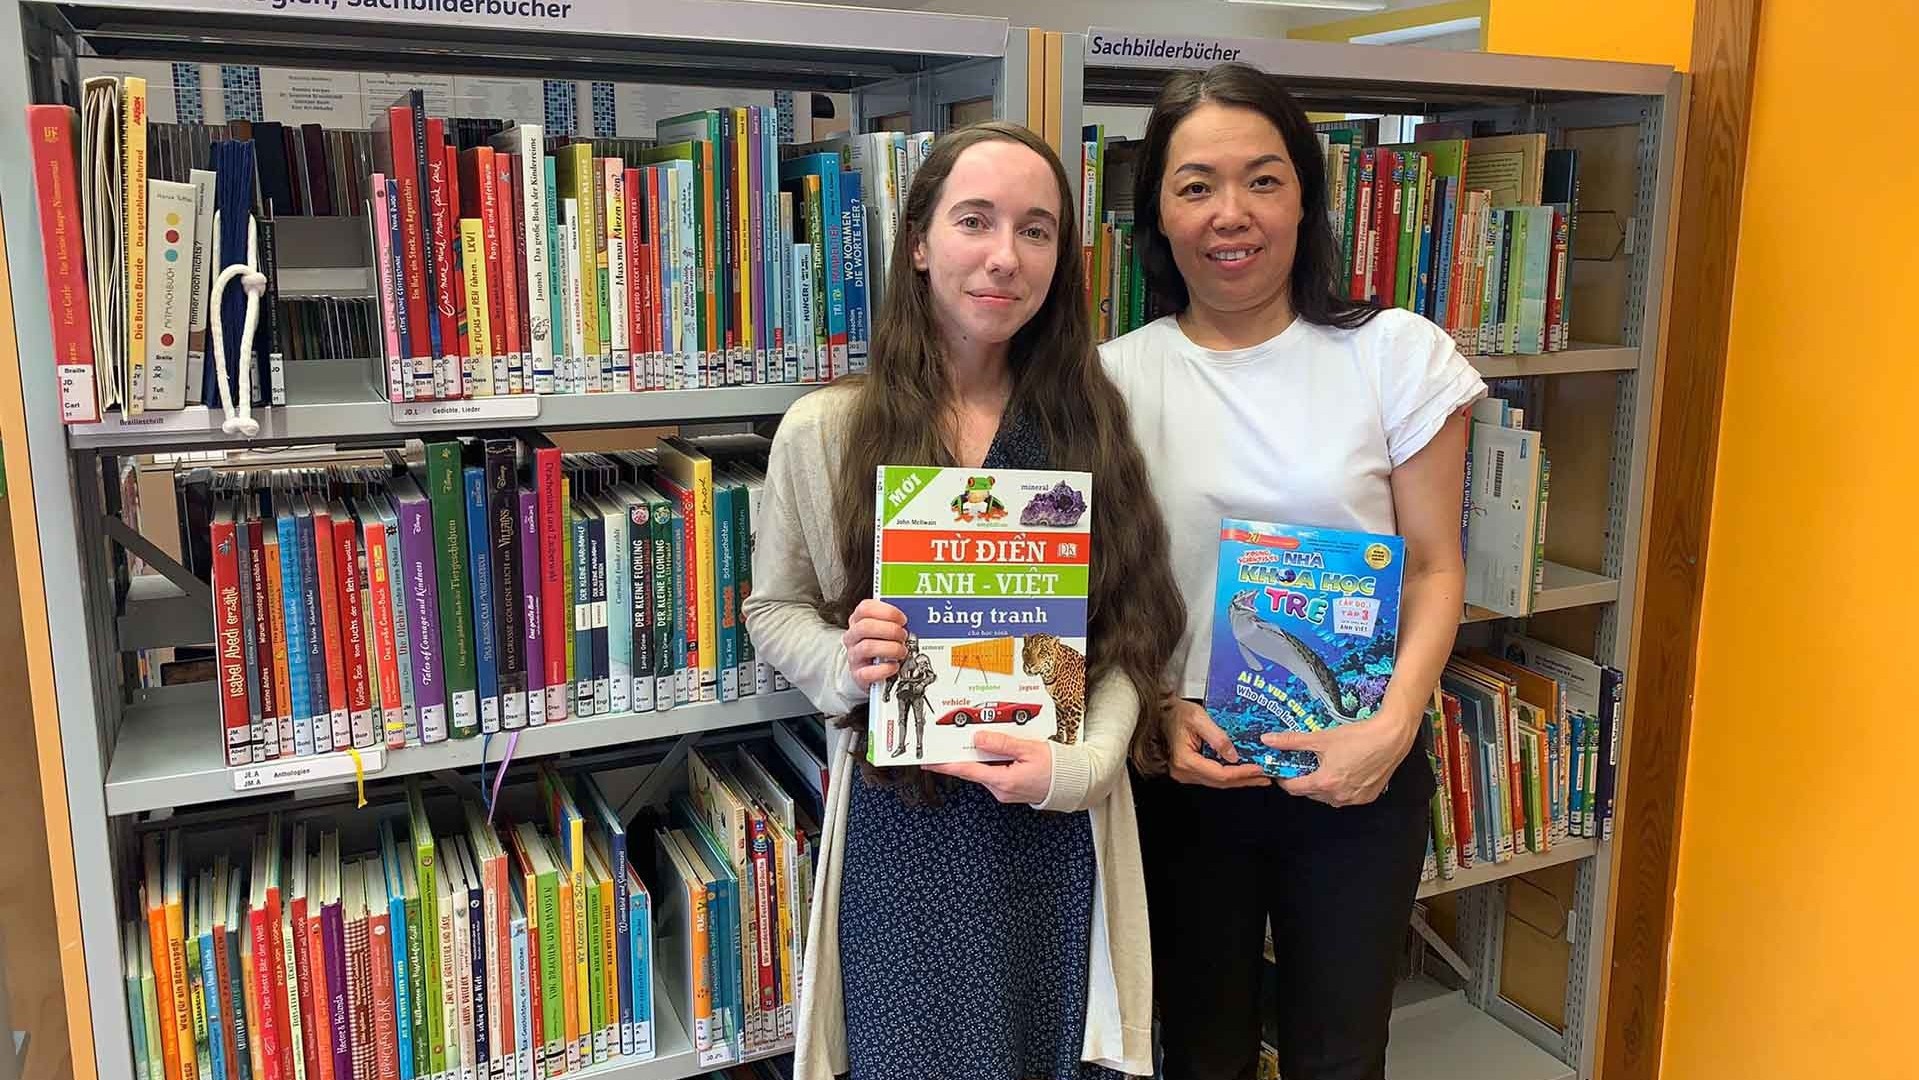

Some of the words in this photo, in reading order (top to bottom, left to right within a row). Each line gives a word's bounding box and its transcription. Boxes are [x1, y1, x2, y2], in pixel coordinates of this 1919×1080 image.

[1091, 36, 1240, 61] Sachbilderbücher
[135, 149, 145, 183] Fahrrad
[528, 137, 538, 186] Kinderreime
[484, 163, 495, 206] Apfelbaum
[530, 186, 538, 201] der
[136, 184, 146, 230] gestohlene
[486, 208, 494, 223] und
[530, 201, 540, 222] Buch
[487, 224, 496, 239] Bär
[612, 206, 623, 240] Miezen
[136, 231, 145, 247] Das
[532, 223, 543, 247] große
[842, 211, 852, 259] KOMMEN
[193, 240, 203, 273] nichts?
[408, 236, 417, 259] Stock,
[488, 239, 498, 260] Pony,
[533, 249, 542, 262] Das
[616, 242, 624, 261] man
[852, 230, 862, 268] WORTE
[135, 257, 144, 290] Bande
[614, 261, 624, 286] Muss
[843, 261, 854, 280] WO
[854, 270, 864, 287] DIE
[191, 274, 201, 296] noch
[534, 271, 544, 301] Janosch
[135, 291, 144, 322] Bunte
[190, 298, 200, 326] Immer
[135, 323, 144, 340] Die
[473, 319, 483, 343] FUCHS
[497, 465, 507, 489] Disney
[413, 513, 422, 535] Disney
[448, 519, 461, 590] Tiergeschichten
[721, 520, 731, 578] Schulgeschichten
[931, 533, 971, 562] TỪ
[975, 532, 1047, 562] ĐIỂN
[633, 539, 643, 579] FLOHLING
[655, 539, 665, 579] FLOHLING
[1283, 551, 1325, 569] NHÀ
[414, 561, 426, 597] Kindness
[578, 566, 587, 587] KLEINE
[914, 572, 976, 595] ANH
[995, 567, 1059, 599] VIỆT
[1320, 572, 1376, 597] HỌC
[221, 586, 237, 624] erzählt
[579, 588, 587, 601] DER
[634, 582, 644, 609] KLEINE
[655, 581, 666, 608] KLEINE
[350, 606, 358, 617] der
[417, 598, 426, 614] and
[927, 601, 984, 628] bằng
[989, 607, 1047, 624] tranh
[1265, 587, 1328, 625] TRẺ
[635, 611, 645, 627] DER
[655, 610, 666, 627] DER
[221, 628, 241, 658] Abedi
[258, 622, 266, 643] Warum
[418, 617, 431, 649] Courage
[419, 650, 432, 661] of
[227, 664, 245, 697] Isabel
[422, 662, 432, 685] Tales
[1238, 671, 1253, 684] Ai
[942, 698, 971, 706] vehicle
[1267, 700, 1283, 717] the
[983, 710, 994, 720] 19
[575, 899, 583, 911] die
[760, 900, 768, 918] Feste
[256, 925, 265, 942] Welt
[761, 919, 769, 951] entdecken
[257, 944, 266, 957] der
[259, 959, 268, 971] Bär
[176, 986, 184, 998] ein
[261, 974, 270, 994] beste
[177, 999, 188, 1012] für
[262, 995, 271, 1010] Der
[377, 996, 392, 1022] BÄR
[475, 993, 483, 1003] die
[179, 1014, 188, 1031] Was
[476, 1012, 485, 1032] schön
[477, 1033, 485, 1042] So
